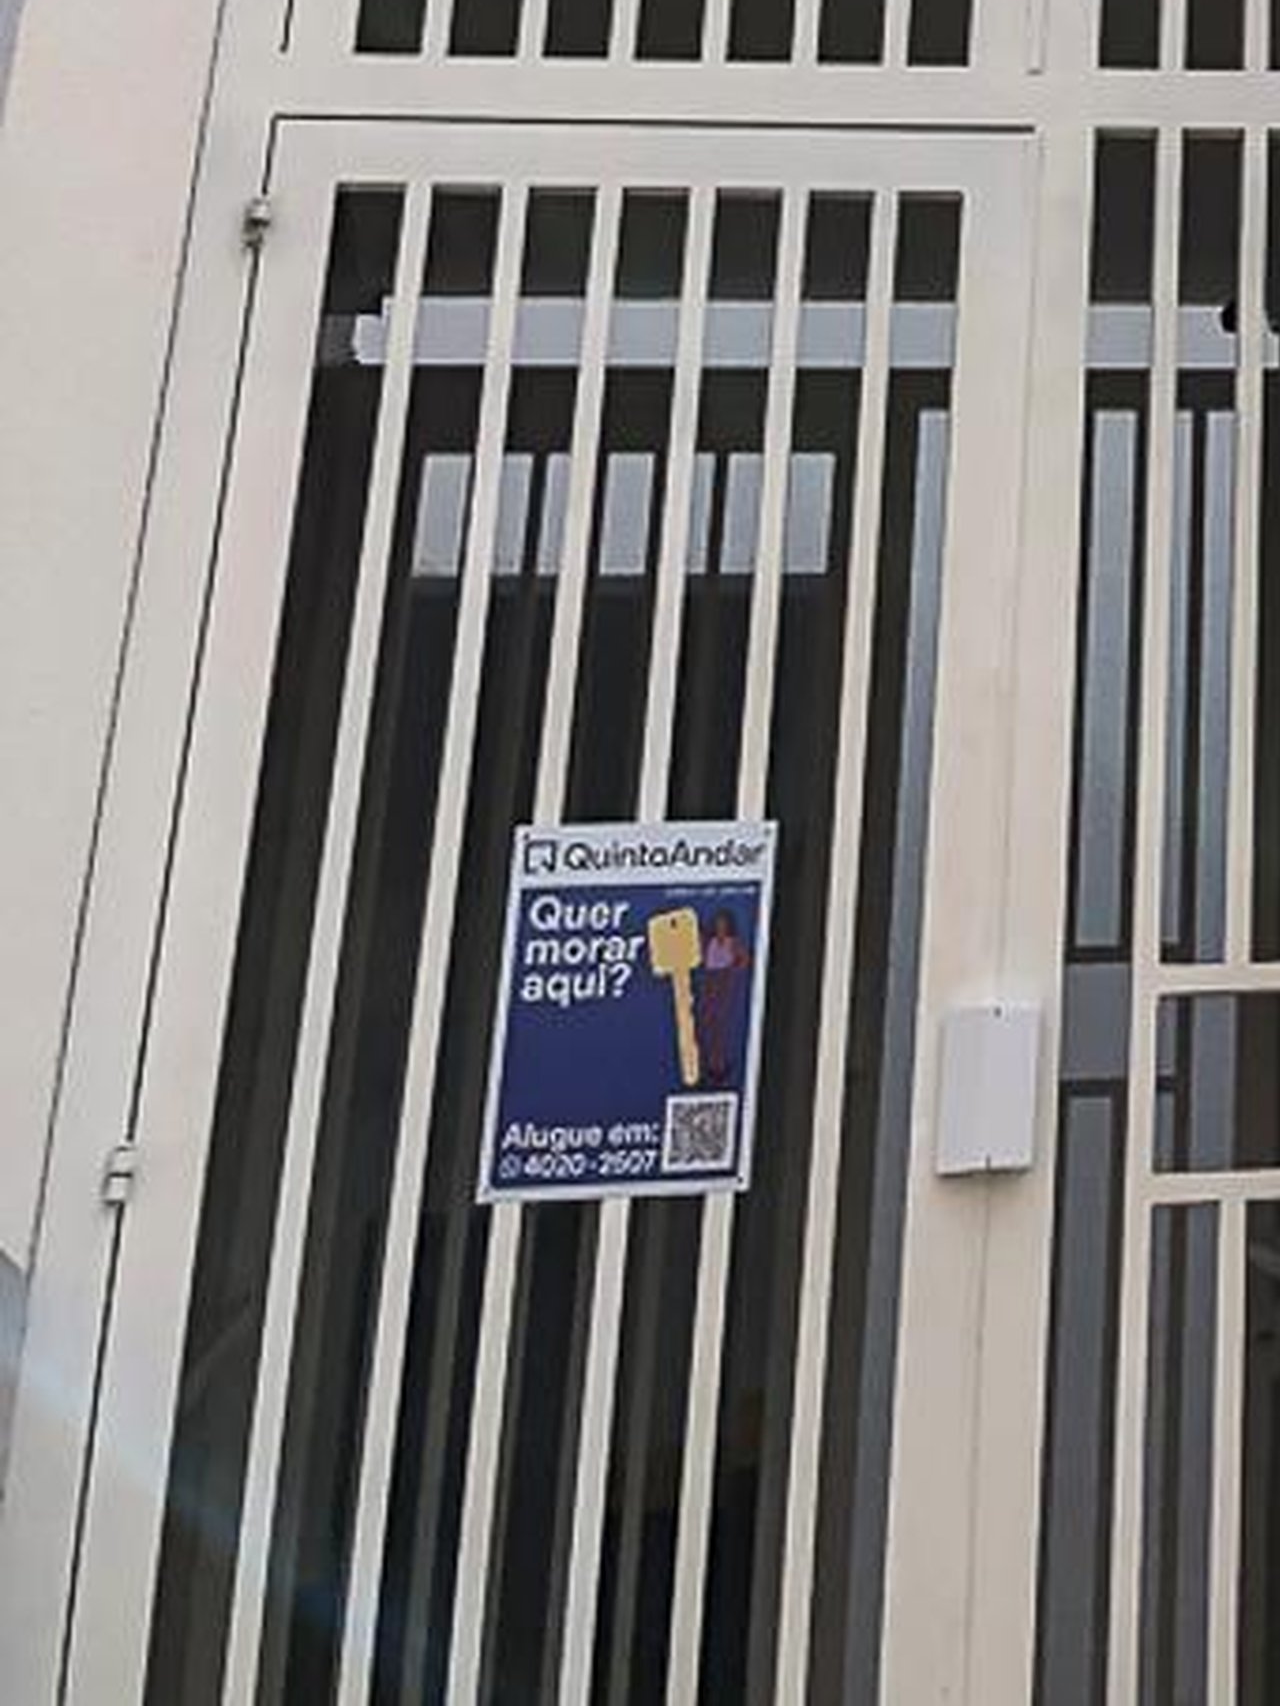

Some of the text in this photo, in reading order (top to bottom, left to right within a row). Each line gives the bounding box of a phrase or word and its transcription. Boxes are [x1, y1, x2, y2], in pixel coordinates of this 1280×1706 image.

[563, 839, 767, 872] QuintoAndar
[530, 895, 630, 932] Quer
[524, 936, 646, 965] morar
[520, 964, 632, 1007] aqui?
[501, 1121, 660, 1153] Alugue em:
